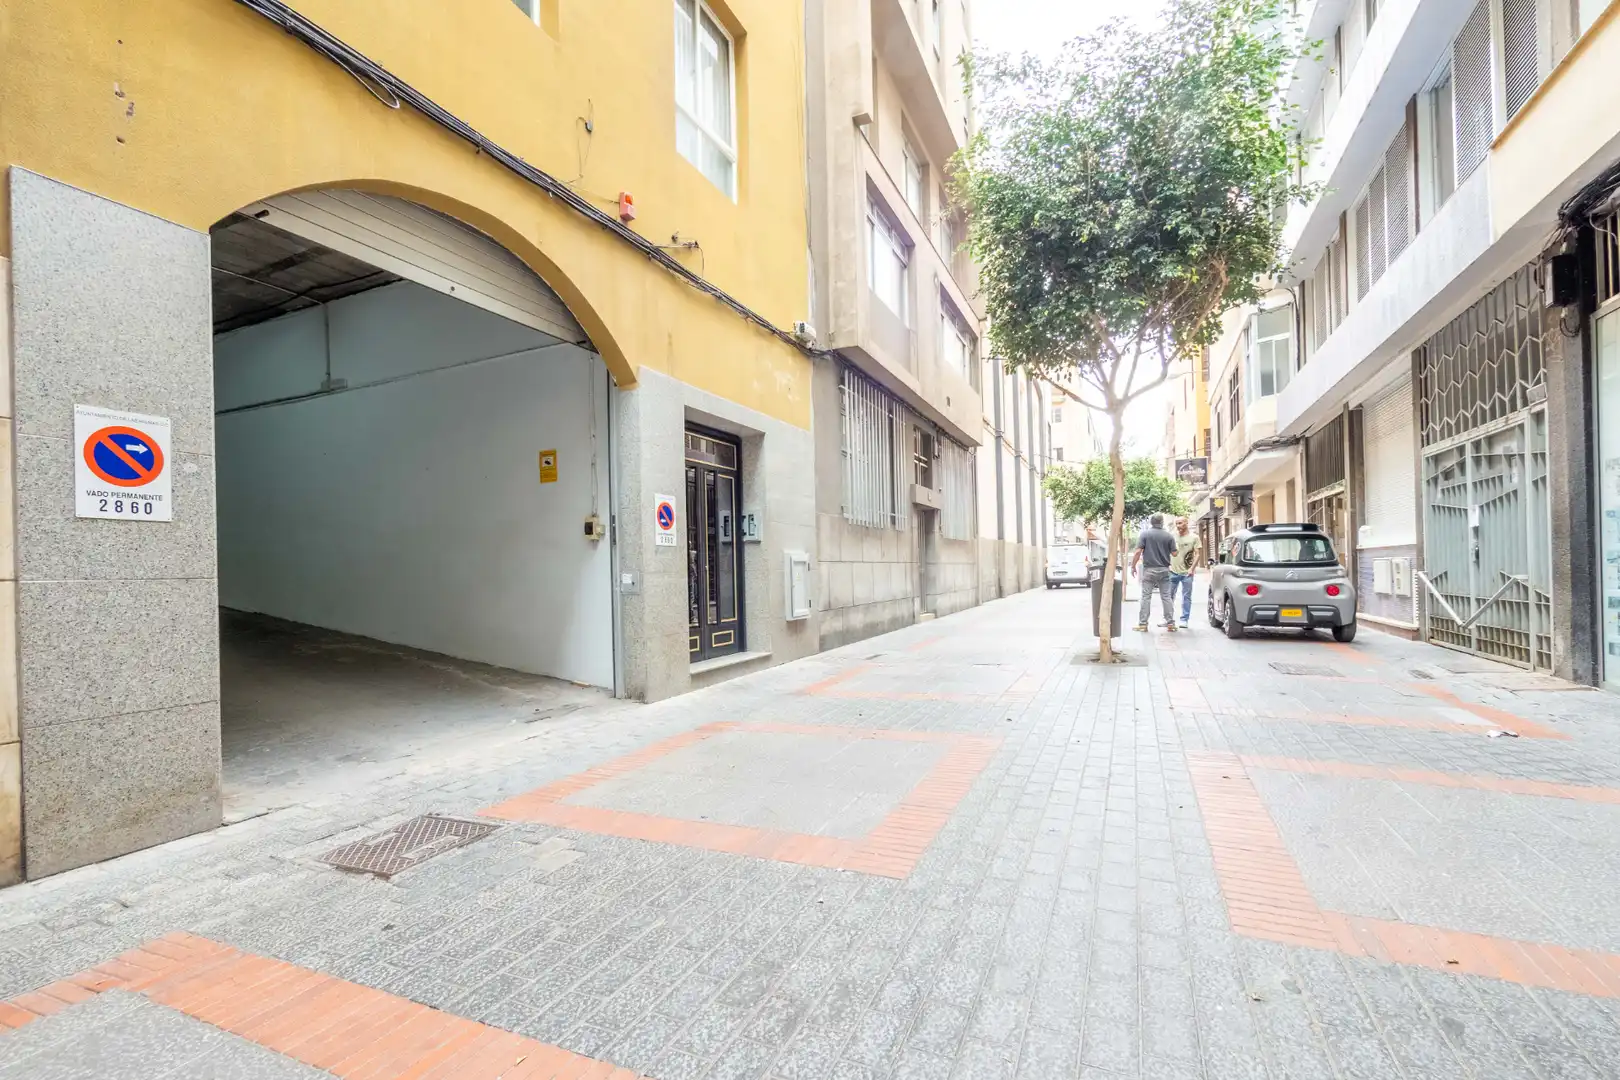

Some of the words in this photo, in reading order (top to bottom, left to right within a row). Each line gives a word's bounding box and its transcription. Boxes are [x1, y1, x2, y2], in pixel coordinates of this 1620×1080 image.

[86, 490, 109, 498] VADO
[111, 491, 163, 501] PERMANENTE
[99, 499, 153, 515] 2860
